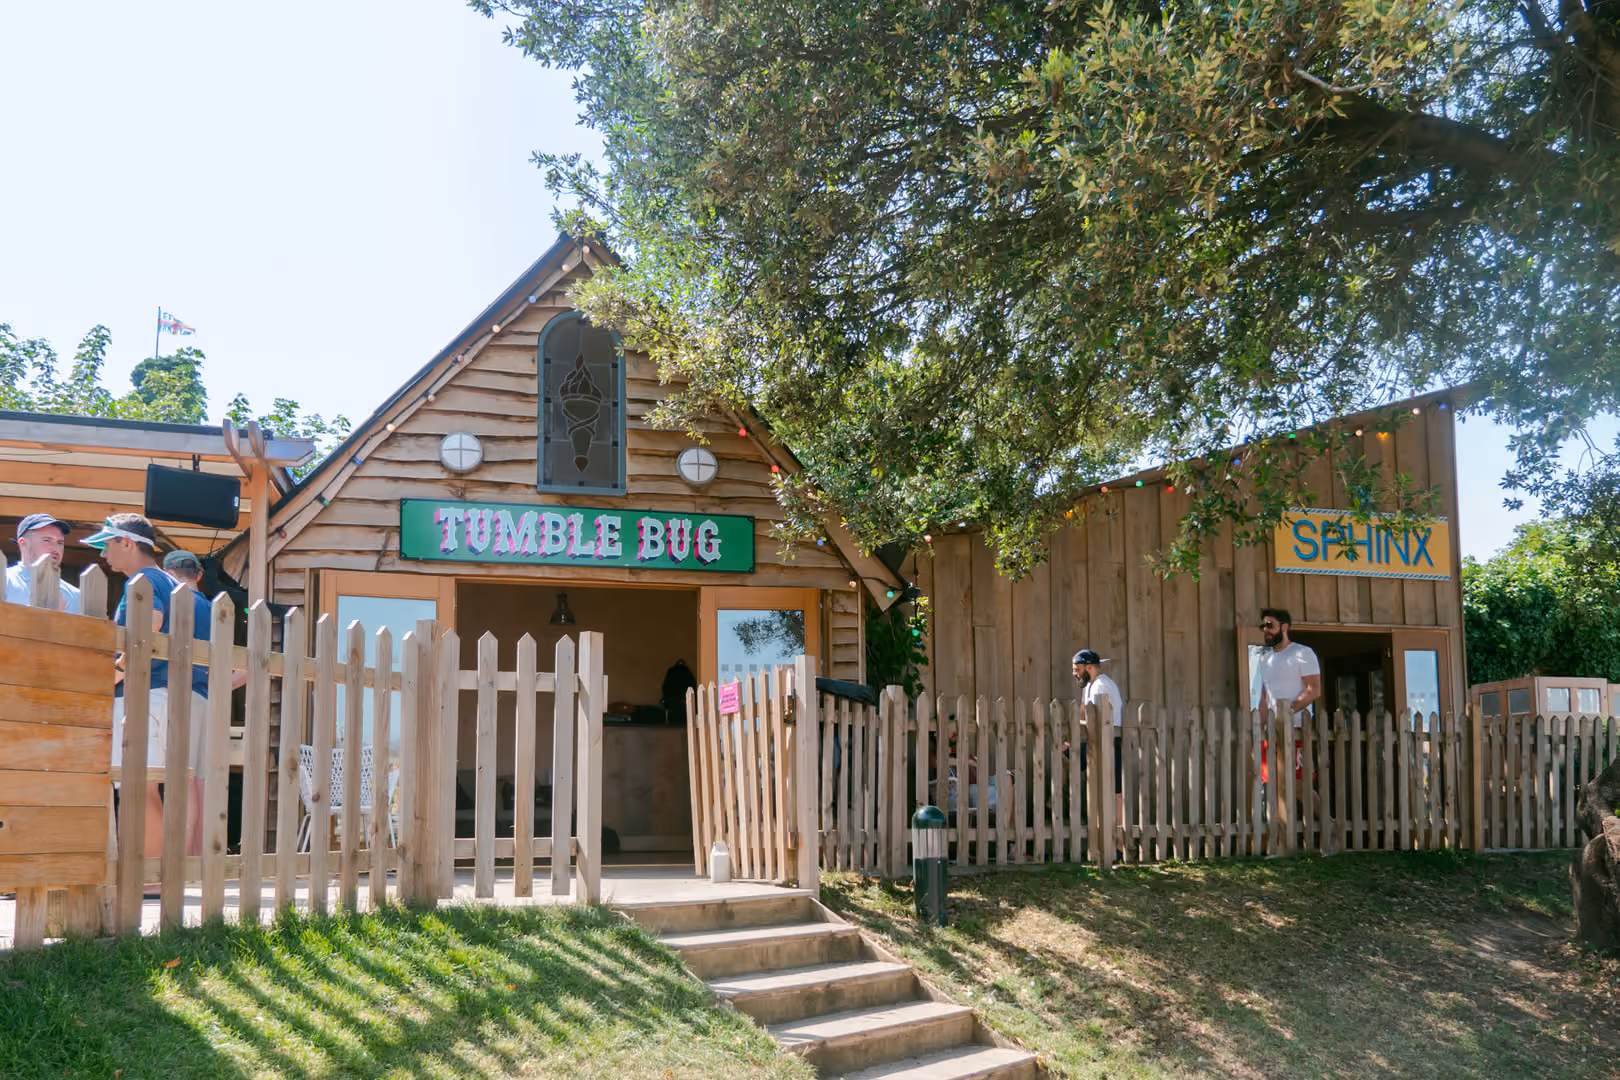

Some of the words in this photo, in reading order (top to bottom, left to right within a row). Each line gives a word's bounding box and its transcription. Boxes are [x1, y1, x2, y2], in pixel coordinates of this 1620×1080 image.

[434, 507, 623, 560] TUMBLE
[637, 515, 722, 565] BUG
[1292, 519, 1434, 567] SPHINX
